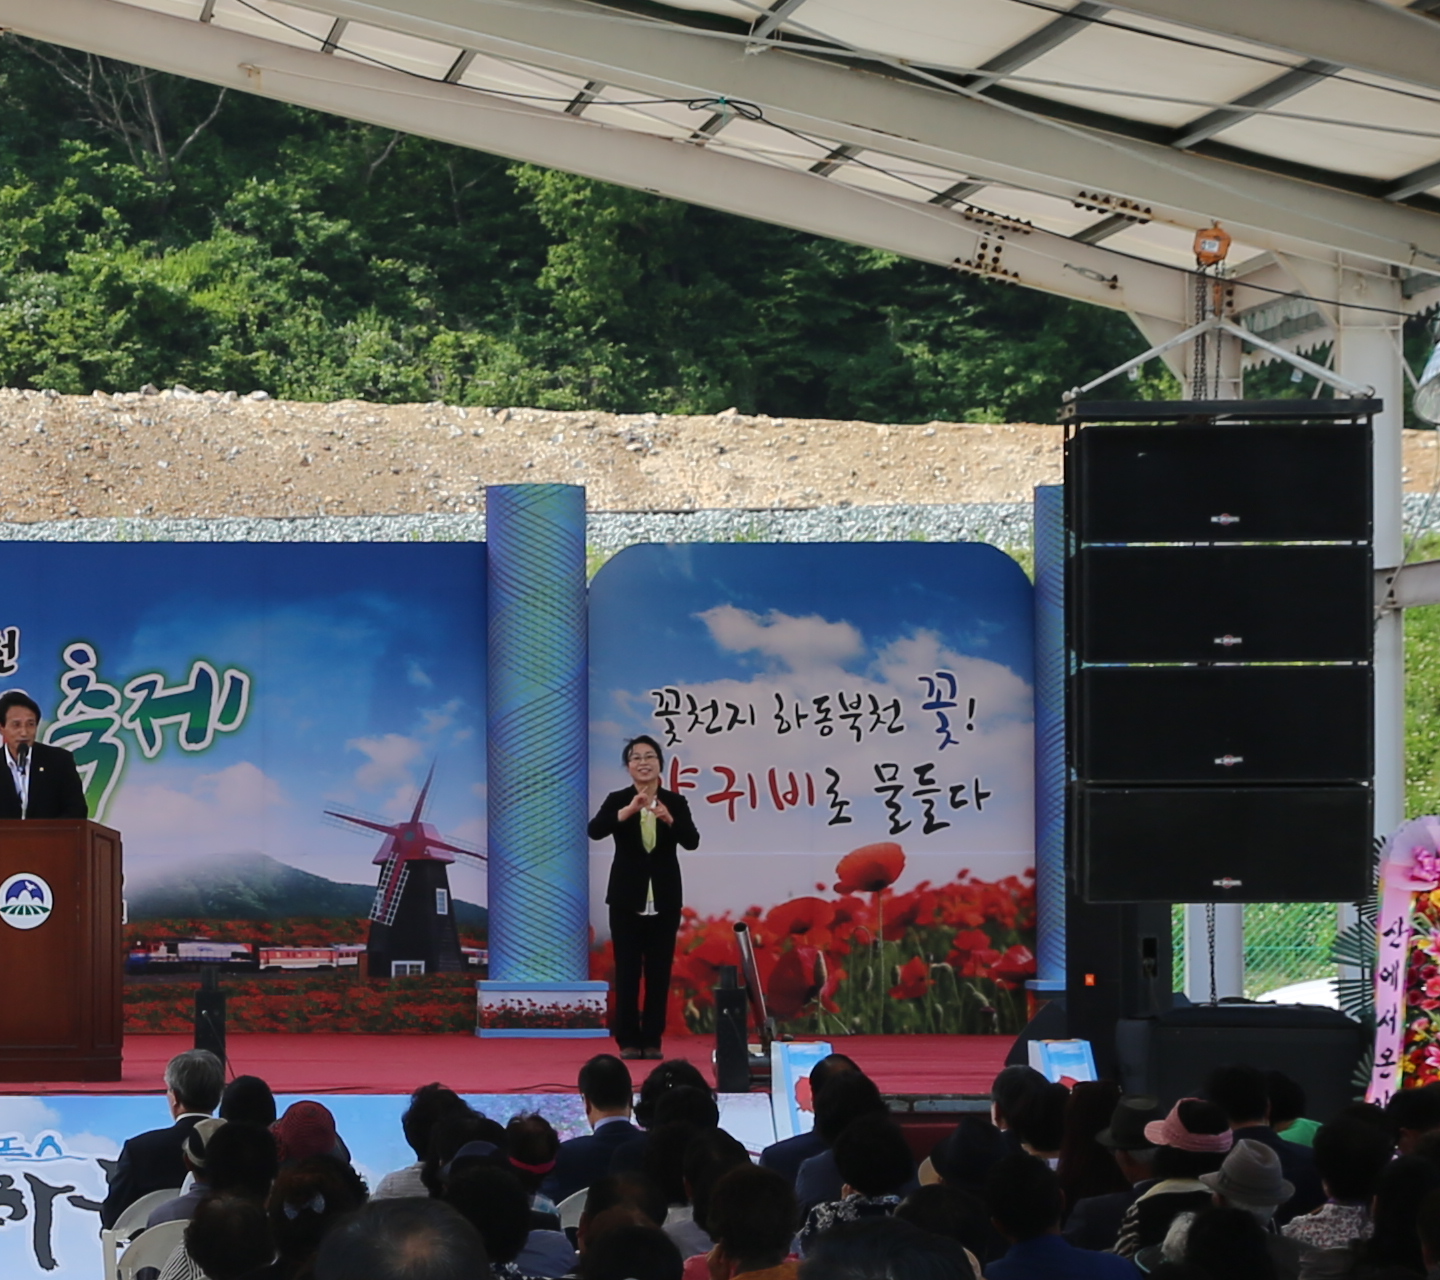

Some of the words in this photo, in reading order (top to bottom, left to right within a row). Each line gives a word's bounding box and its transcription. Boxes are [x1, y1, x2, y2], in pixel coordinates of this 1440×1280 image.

[652, 688, 755, 747] 꽃천지
[772, 691, 904, 742] 하동북천
[918, 671, 977, 751] 꽃!
[874, 762, 991, 835] 물들다
